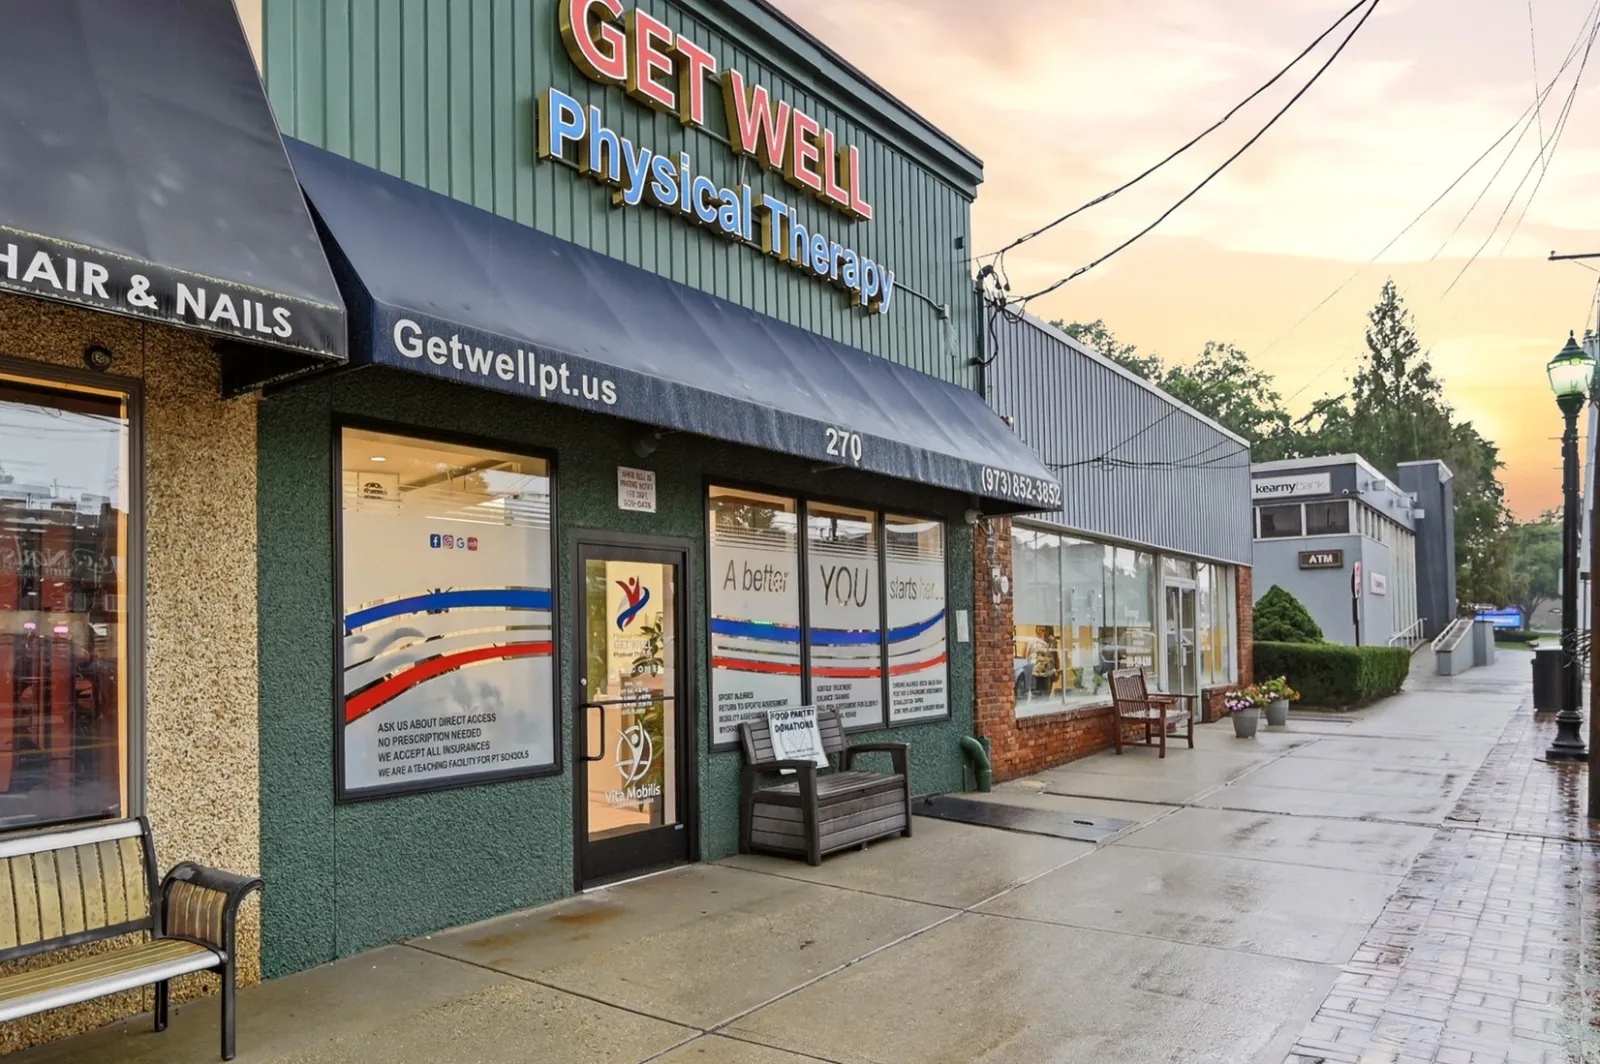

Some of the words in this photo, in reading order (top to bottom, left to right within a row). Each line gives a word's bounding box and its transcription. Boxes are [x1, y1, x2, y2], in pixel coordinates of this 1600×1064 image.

[567, 0, 716, 126] GET
[729, 67, 872, 220] WELL
[549, 87, 752, 241] Physical
[763, 194, 895, 314] Therapy
[0, 243, 109, 299] HAIR
[126, 275, 158, 310] &
[176, 282, 293, 338] NAILS
[393, 319, 618, 405] Getwellpt.us
[825, 427, 862, 461] 270
[1308, 554, 1333, 564] ATM
[722, 559, 737, 591] A
[742, 560, 789, 592] better
[820, 565, 869, 608] YOU
[890, 576, 917, 600] starts
[378, 722, 395, 733] ASK
[396, 721, 408, 731] US
[410, 717, 437, 730] ABOUT
[438, 715, 466, 727] DIRECT
[467, 713, 497, 724] ACCESS
[771, 711, 789, 721] FOOD
[774, 720, 814, 733] DONATIONS
[378, 737, 390, 748] NO
[392, 730, 450, 746] PRESCRIPTION
[451, 728, 482, 740] NEEDED
[378, 751, 391, 762] WE
[393, 747, 425, 761] ACCEPT
[426, 745, 441, 757] ALL
[442, 741, 491, 755] INSURANCES
[378, 768, 391, 778] WE
[391, 764, 406, 776] ARE
[407, 763, 413, 774] A
[413, 759, 448, 773] TEACHING
[477, 754, 491, 764] FOR
[491, 753, 500, 763] PT
[605, 789, 625, 804] Vita
[626, 783, 661, 800] Mobilis
